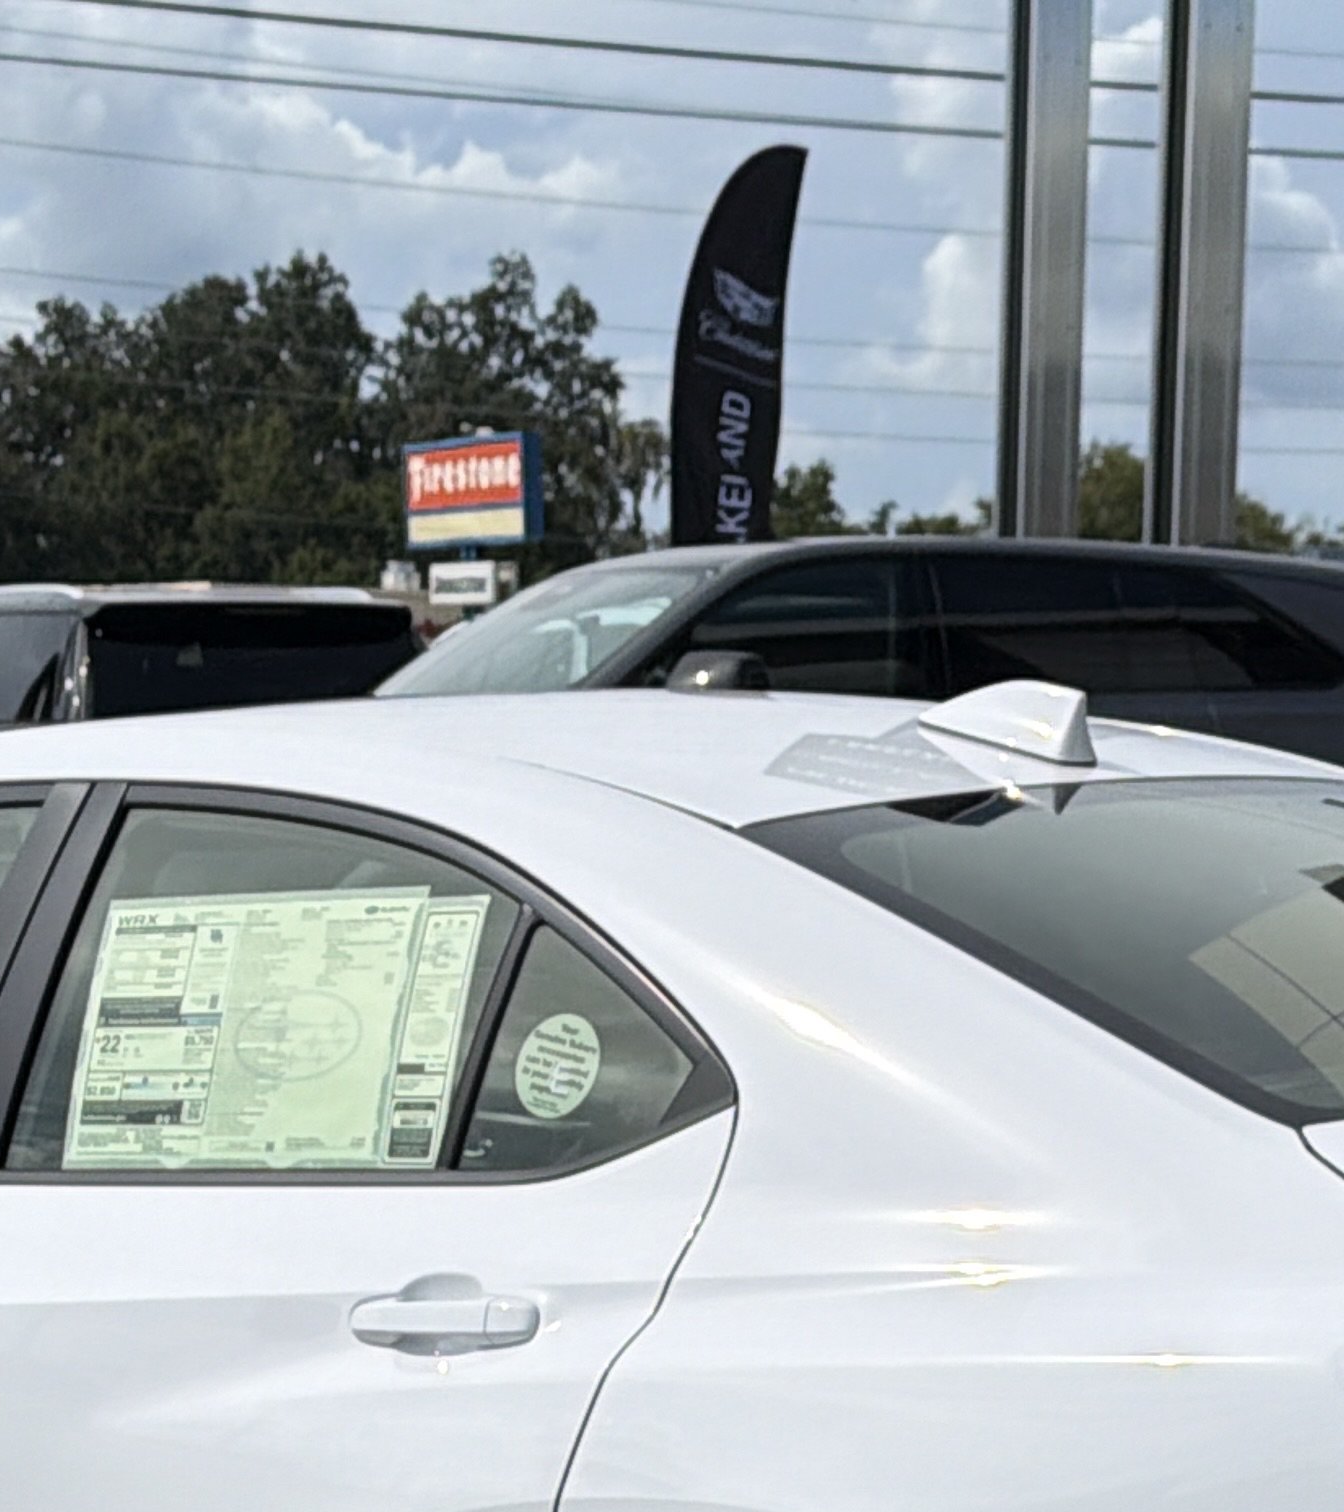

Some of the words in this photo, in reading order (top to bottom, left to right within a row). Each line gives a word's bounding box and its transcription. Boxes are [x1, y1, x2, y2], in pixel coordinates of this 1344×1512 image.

[408, 453, 522, 503] Firestone
[715, 389, 753, 545] KELAND
[118, 913, 160, 926] WRX
[99, 1034, 122, 1054] 22
